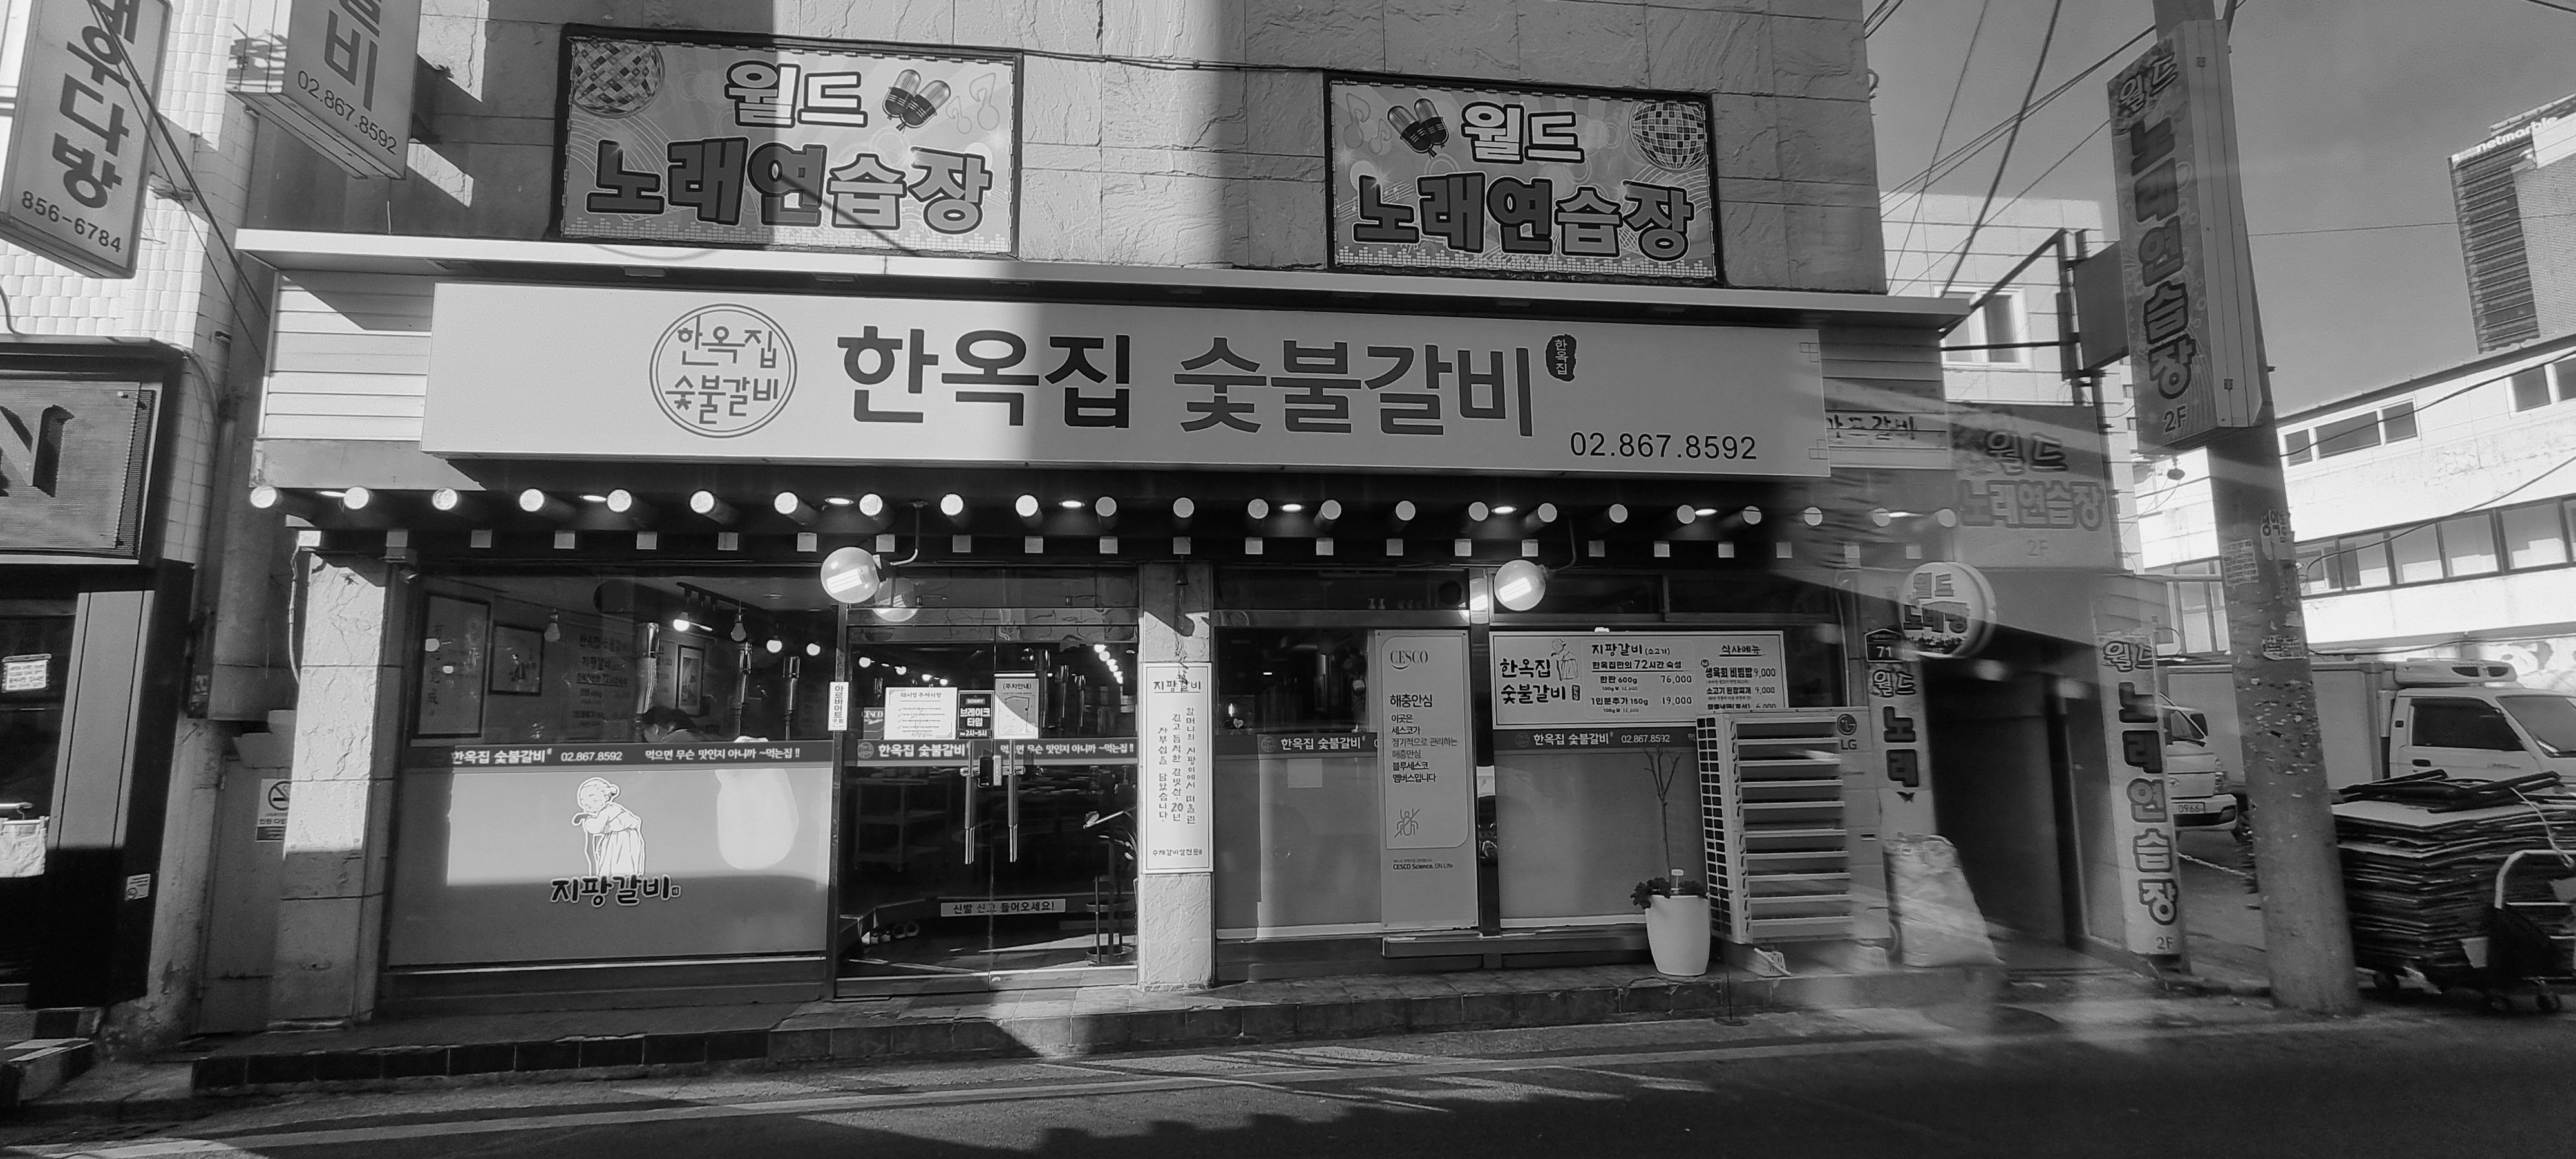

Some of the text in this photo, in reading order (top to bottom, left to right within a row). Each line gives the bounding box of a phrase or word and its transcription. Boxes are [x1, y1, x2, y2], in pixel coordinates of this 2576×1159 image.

[2117, 52, 2177, 118] 월드
[724, 61, 867, 127] 월드
[297, 70, 397, 155] 02.867.8592
[1461, 101, 1585, 164] 월드
[2476, 117, 2559, 152] netmarble
[586, 136, 993, 234] 노래연습장
[21, 191, 122, 253] 856-6784
[1352, 171, 1694, 261] 노래연습장
[678, 315, 777, 368] 한옥집
[1555, 339, 1568, 375] 한옥집
[837, 326, 1533, 437] 한옥집 숯불갈비
[665, 375, 779, 424] 숯불갈비
[2163, 406, 2187, 433] 2F
[1570, 432, 1757, 460] 02.867.8592
[1986, 431, 2069, 475] 월드
[2027, 540, 2049, 556] 2F
[1390, 650, 1428, 664] CESCO
[1591, 643, 1642, 656] 지팡갈비
[1721, 645, 1761, 654] 식사메뉴
[1877, 646, 1891, 657] 71
[1500, 658, 1551, 678] 한옥집
[1634, 659, 1664, 669] 72시간
[1666, 661, 1681, 669] 숙성
[1660, 675, 1692, 684] 76,000
[1754, 668, 1776, 679] 9,000
[1153, 679, 1200, 693] 지팡갈비
[1755, 686, 1776, 695] 9,000
[1871, 670, 1917, 698] 월드
[834, 685, 844, 718] 아르바이트
[1390, 693, 1432, 708] 해충안심
[1501, 684, 1566, 704] 숯불갈비
[1662, 697, 1692, 705] 19,000
[960, 708, 991, 717] 브레이크
[1391, 713, 1414, 723] 이곳은
[967, 717, 983, 727] 타임
[1391, 726, 1421, 735] 세스코가
[1158, 728, 1168, 765] 자부심을
[1280, 738, 1314, 751] 한옥집
[1318, 737, 1361, 749] 숯불갈비
[1392, 737, 1458, 747] 정기적으로 관리하는
[1533, 733, 1564, 746] 한옥집
[1568, 732, 1609, 745] 숯불갈비
[1621, 734, 1671, 743] 02.867.8592
[1840, 739, 1857, 749] LG
[451, 749, 623, 764] 한옥집 숯불갈비 02.867.8592
[645, 749, 674, 760] 먹으면
[676, 749, 695, 760] 무슨
[698, 748, 726, 760] 맛인지
[728, 748, 757, 760] 아니까
[878, 744, 914, 758] 한옥집
[918, 743, 965, 758] 숯불갈비
[1000, 744, 1024, 755] 먹면
[1046, 744, 1070, 754] 맛인지
[1072, 744, 1096, 754] 아니까
[1172, 735, 1182, 763] 듬직한
[1392, 749, 1421, 759] 해충안심
[1186, 707, 1197, 824] 할머니의 지팡이에서 떠올린
[1393, 761, 1429, 771] 블루세스코
[1392, 773, 1437, 783] 멤버스입니다
[1171, 802, 1184, 822] 20년
[551, 874, 670, 908] 지팡갈비
[953, 904, 973, 914] 신발
[2155, 936, 2174, 950] 2F
